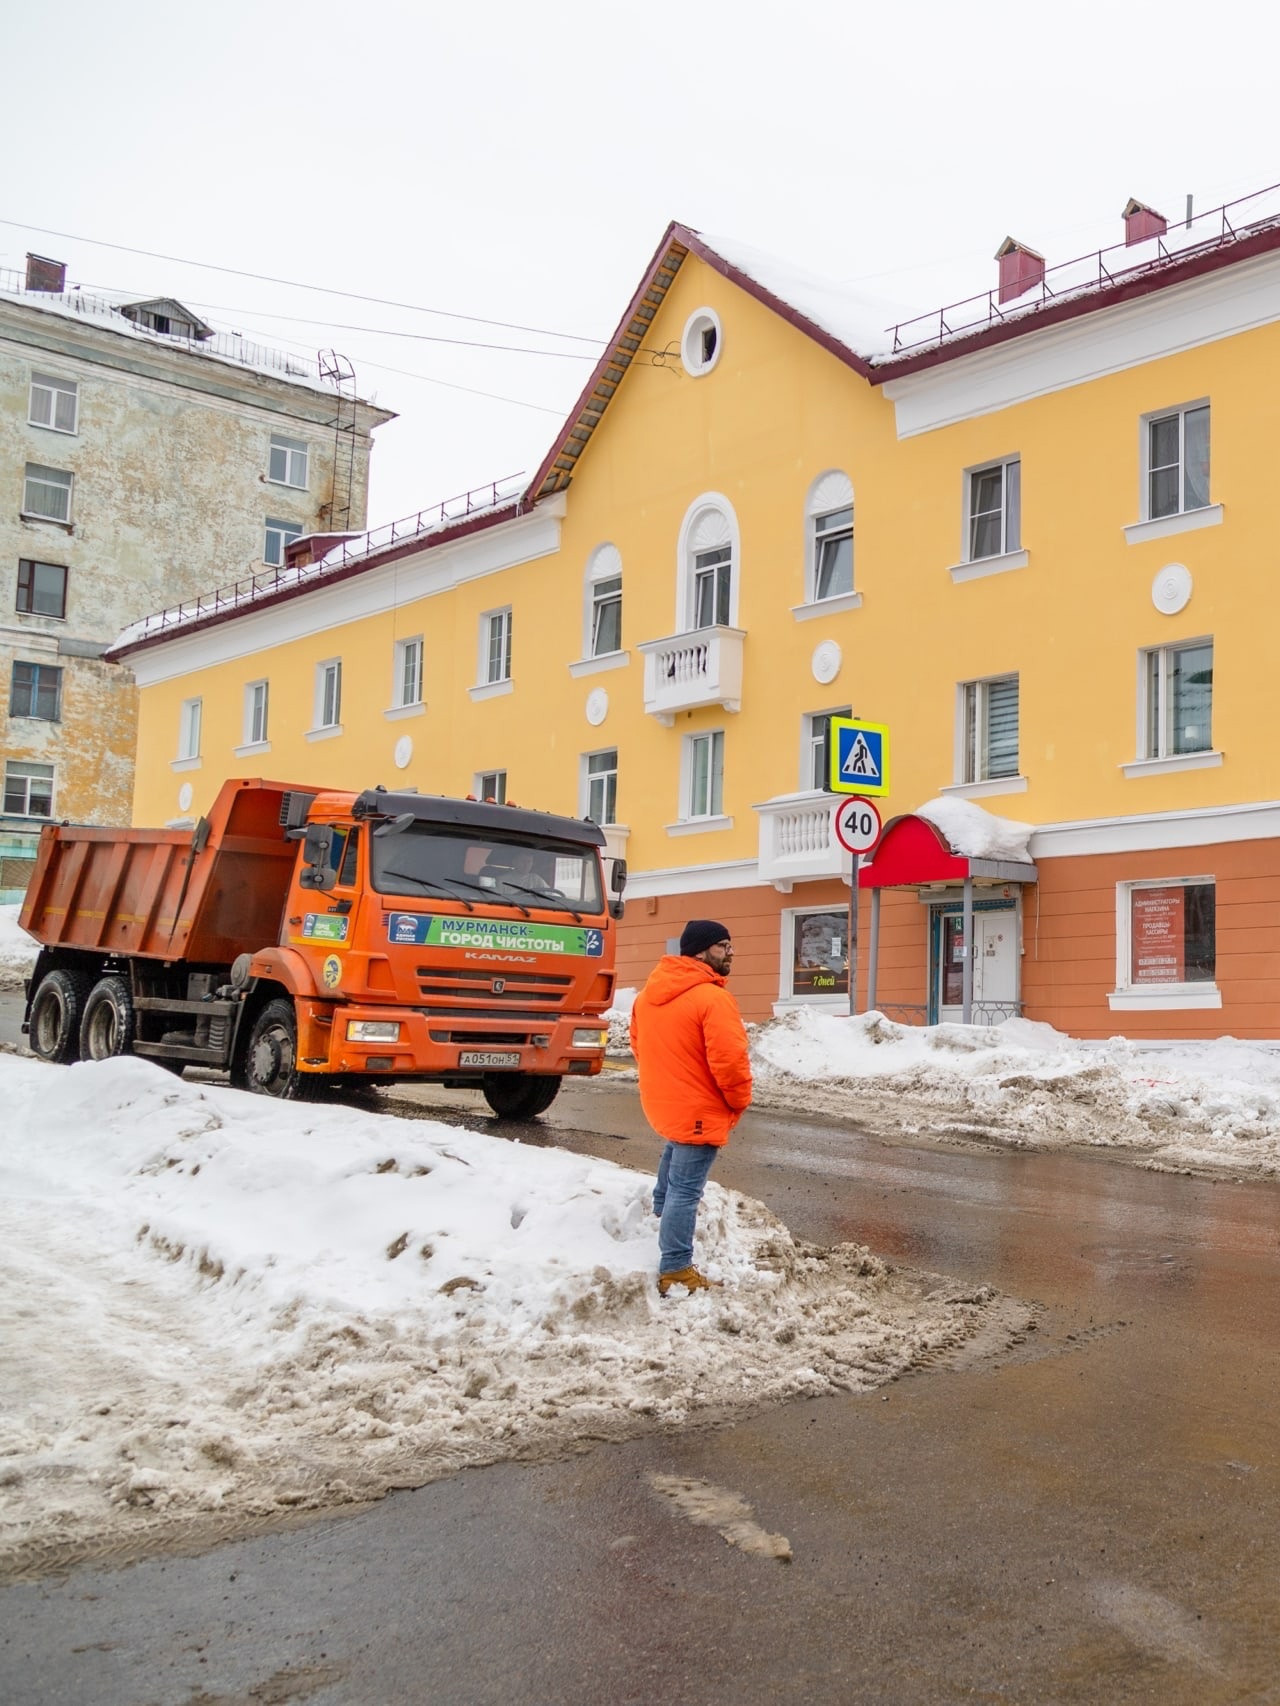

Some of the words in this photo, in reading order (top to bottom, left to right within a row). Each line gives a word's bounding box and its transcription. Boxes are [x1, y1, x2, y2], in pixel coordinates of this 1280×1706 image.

[845, 811, 872, 835] 40
[442, 920, 534, 936] МУРМАНСК-
[440, 932, 494, 948] ГОРОД
[495, 935, 565, 951] ЧИСТОТЫ
[813, 976, 818, 986] 7
[818, 975, 835, 986] дней
